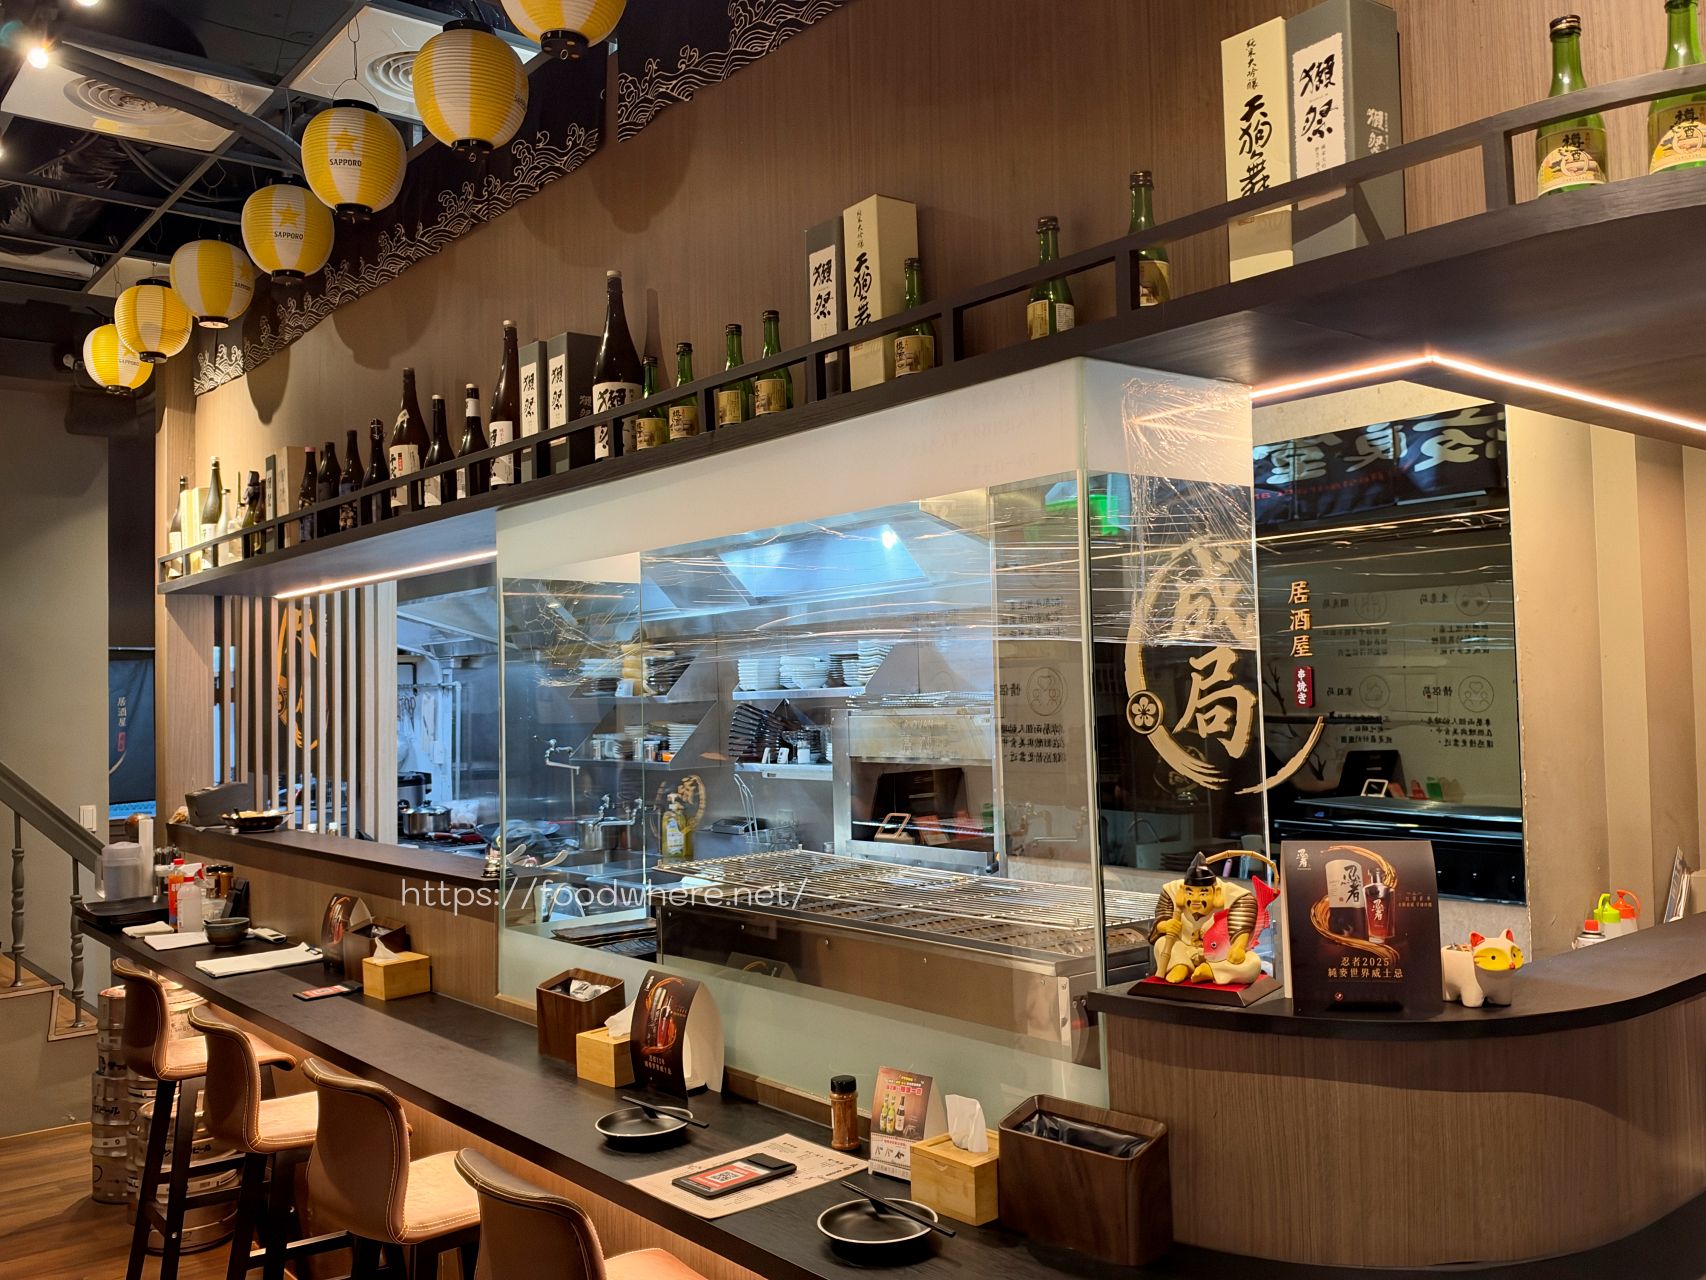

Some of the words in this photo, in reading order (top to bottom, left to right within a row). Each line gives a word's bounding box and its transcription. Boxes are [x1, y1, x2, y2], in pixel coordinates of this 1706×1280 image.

[1299, 54, 1339, 142] 獺祭
[329, 158, 362, 167] SAPPORO
[1239, 94, 1273, 198] 天狗舞
[274, 231, 304, 240] SAPPORO
[812, 258, 834, 320] 獺祭
[853, 252, 872, 327] 天狗舞
[1288, 580, 1313, 657] 居酒屋
[1341, 864, 1362, 903] 忍者
[1327, 968, 1403, 979] 純麥世界威士忌
[1340, 956, 1390, 967] 忍者2025
